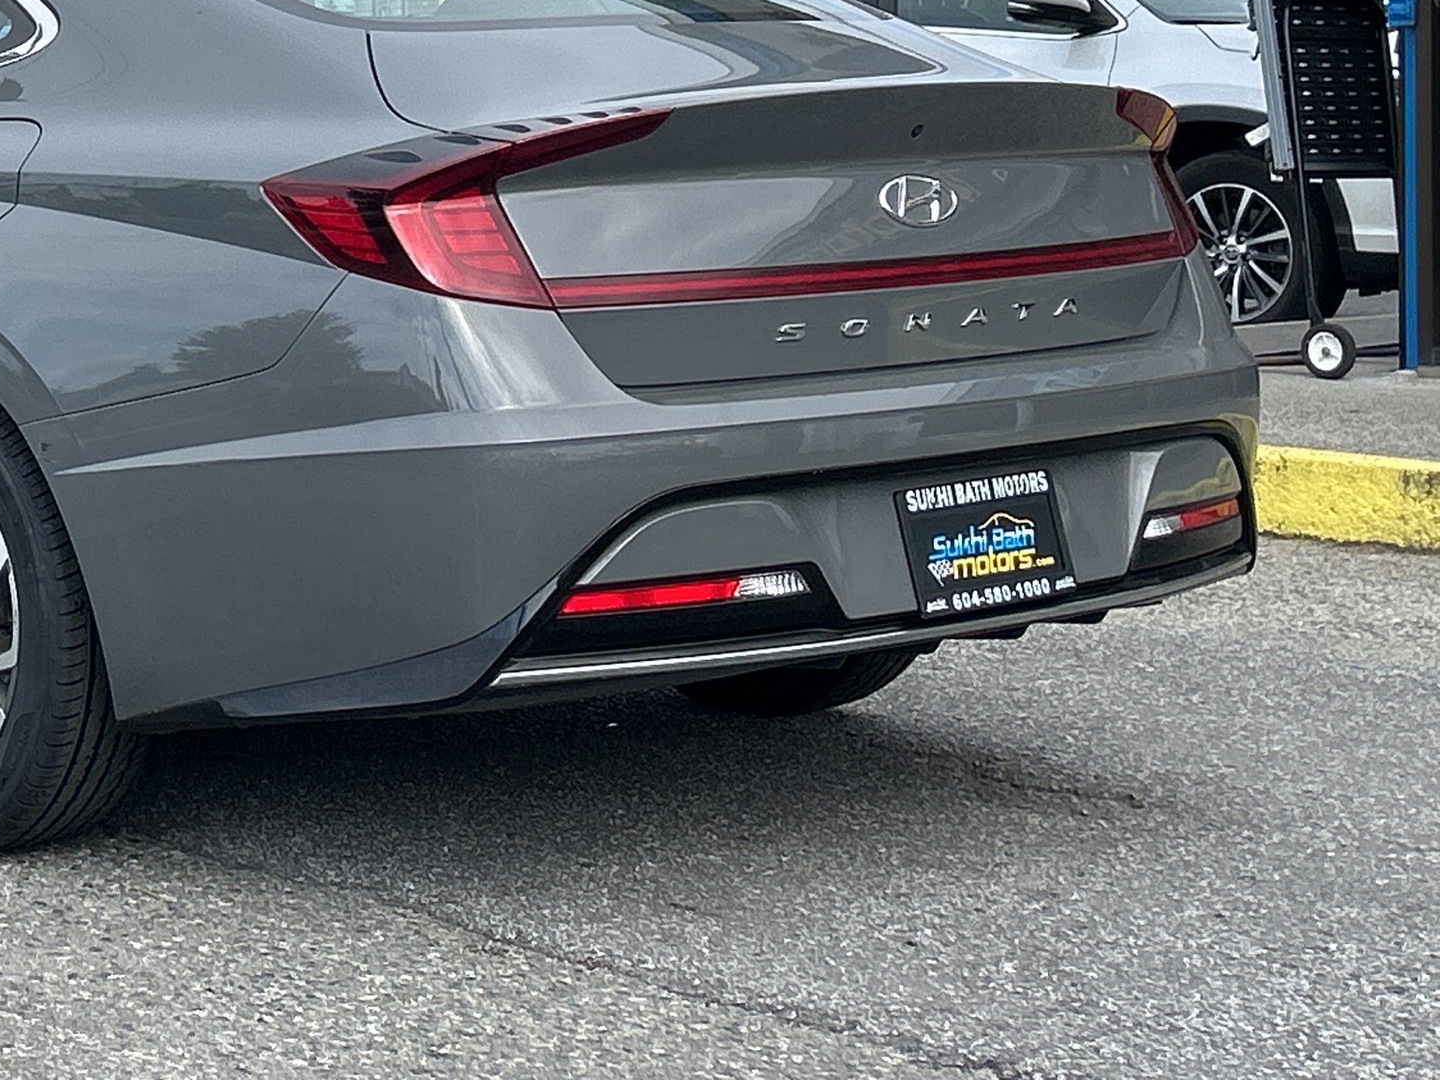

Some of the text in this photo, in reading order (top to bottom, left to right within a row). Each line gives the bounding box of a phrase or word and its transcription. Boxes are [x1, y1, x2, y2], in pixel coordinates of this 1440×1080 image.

[775, 297, 1079, 343] SONATA
[905, 470, 1049, 512] SUKHI BATH MOTORS
[928, 523, 1036, 561] Sukhi Bath
[951, 576, 1051, 611] 604-580-1000
